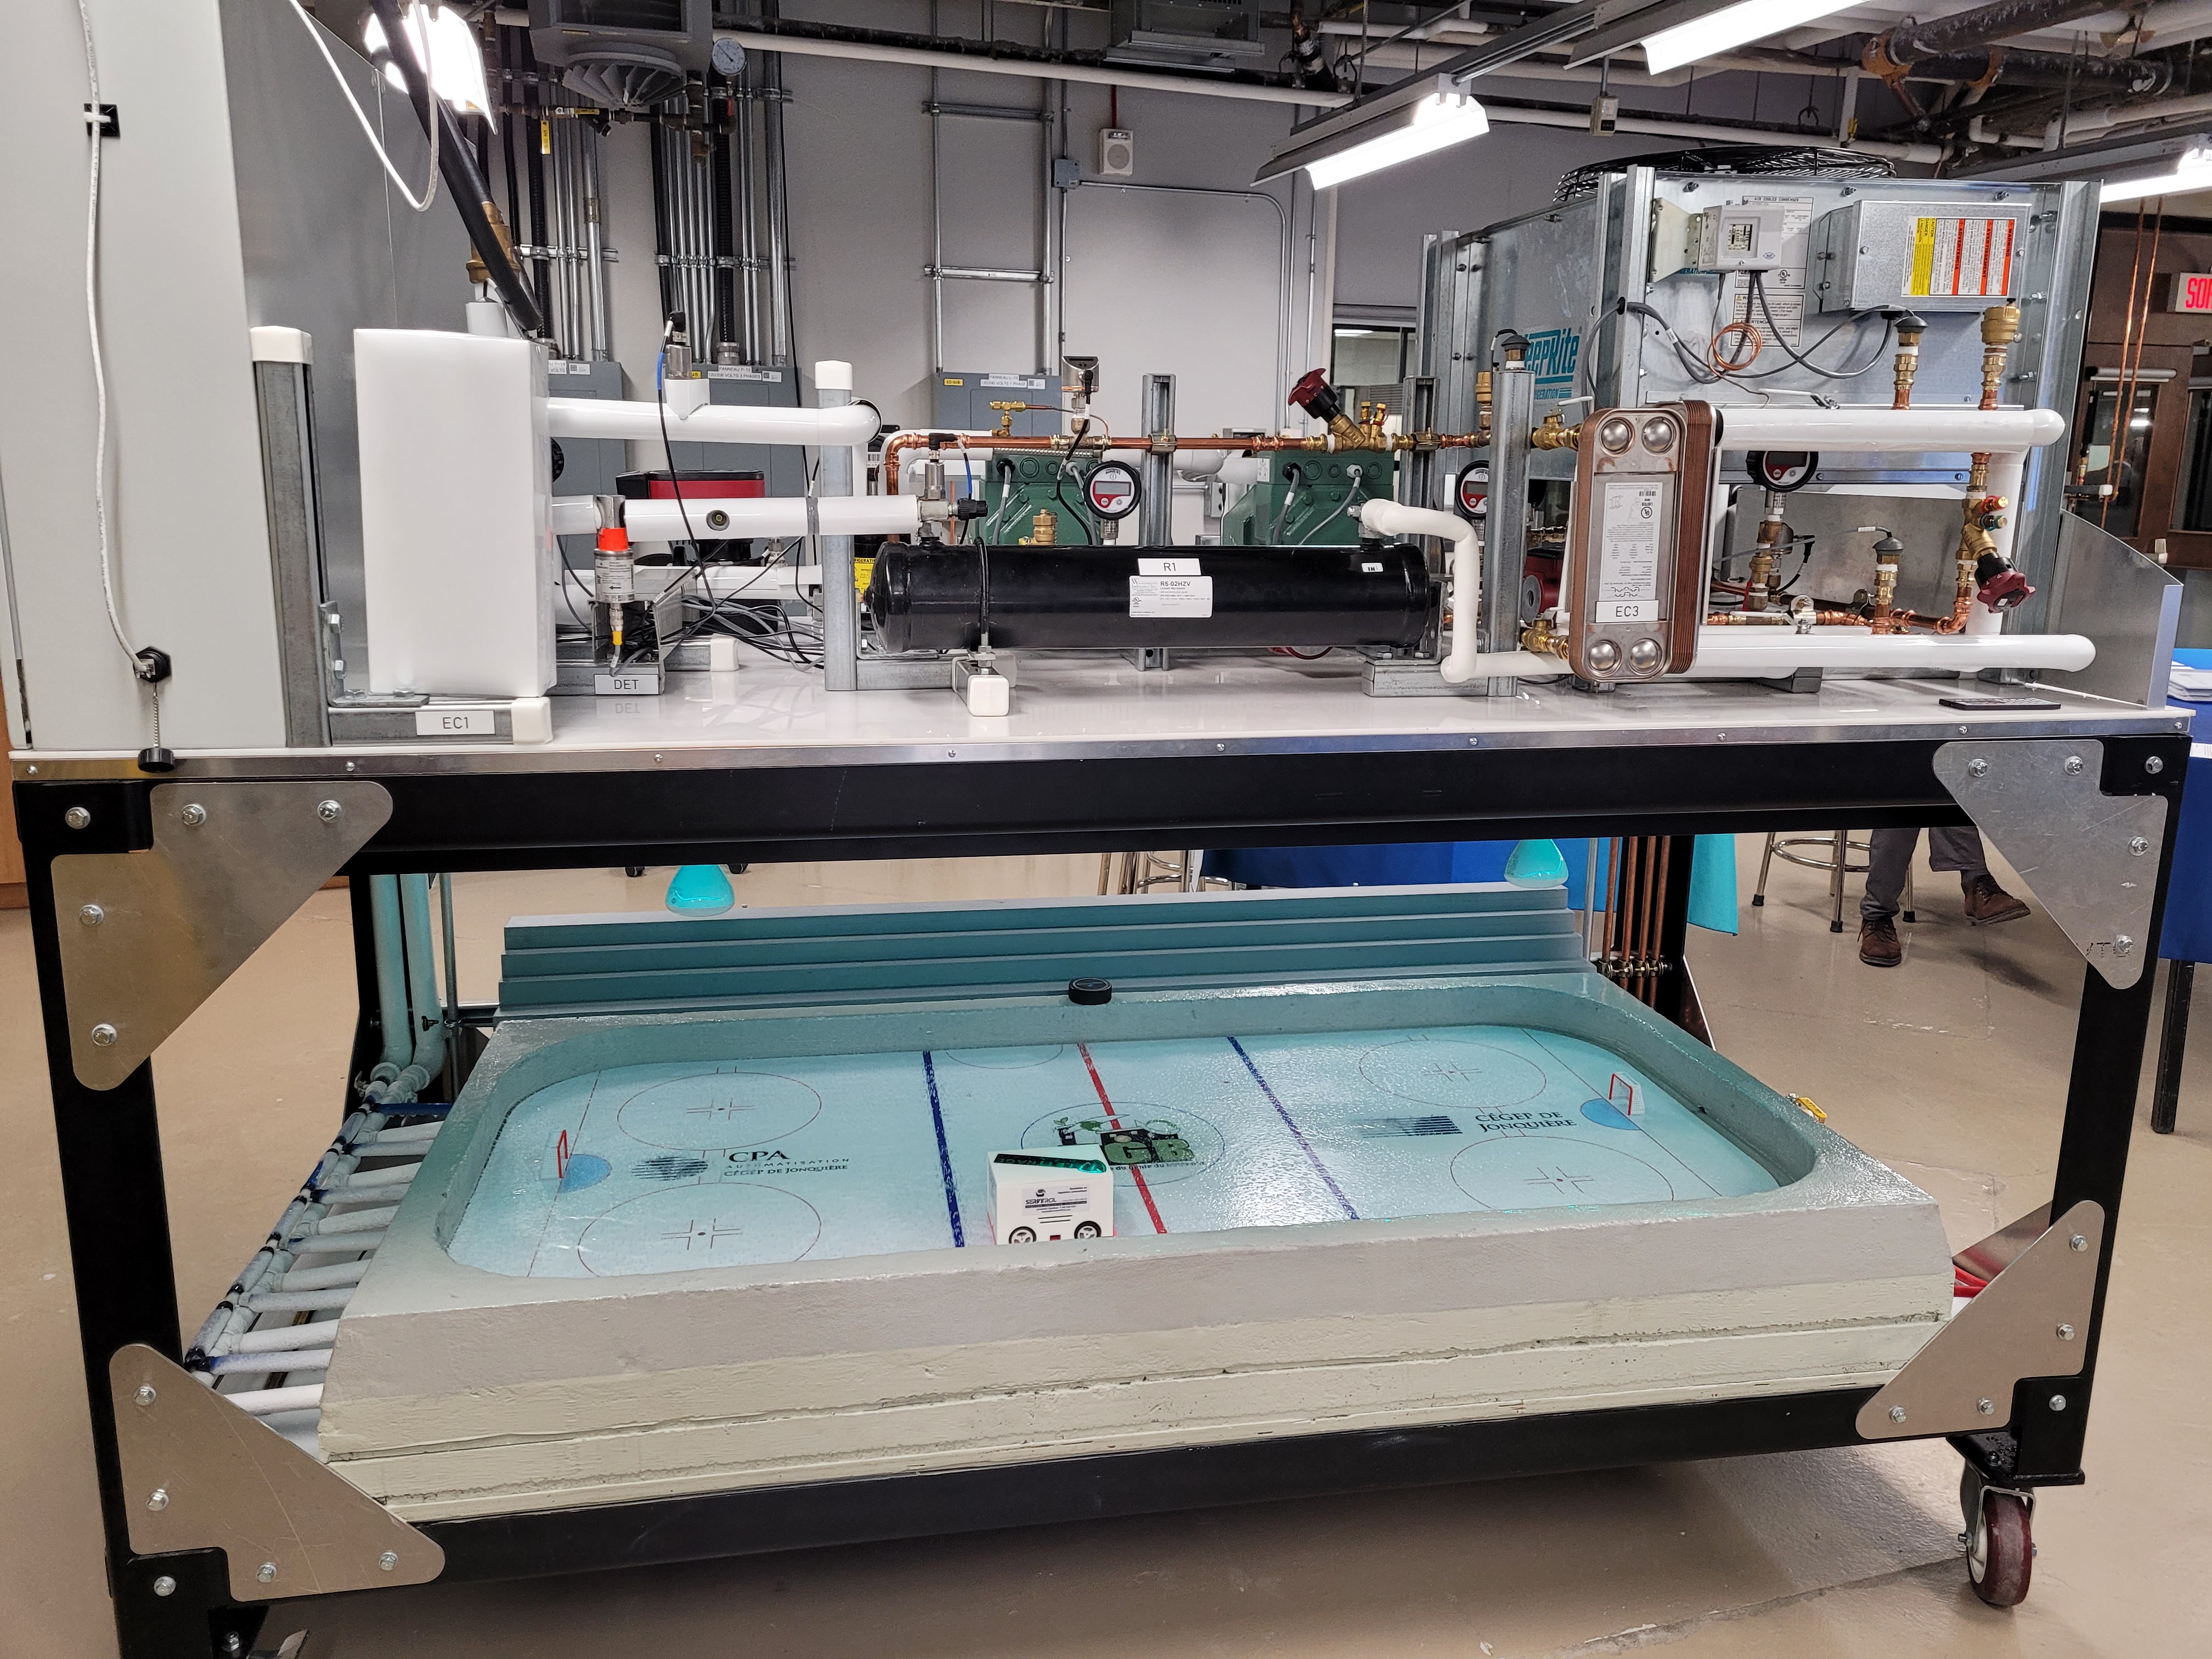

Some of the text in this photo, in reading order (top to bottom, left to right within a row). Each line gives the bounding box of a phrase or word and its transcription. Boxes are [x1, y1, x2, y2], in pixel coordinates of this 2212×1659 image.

[1955, 227, 1963, 270] ADVERTENCIA
[1982, 228, 1991, 278] AVERTISSEMENT
[1164, 562, 1176, 571] R1
[1616, 606, 1639, 617] EC3
[614, 679, 639, 690] DET
[443, 716, 469, 729] EC1
[1475, 1113, 1533, 1122] CÉGEP
[1477, 1120, 1577, 1132] JONQUIÈRE
[729, 1150, 791, 1163] CPA
